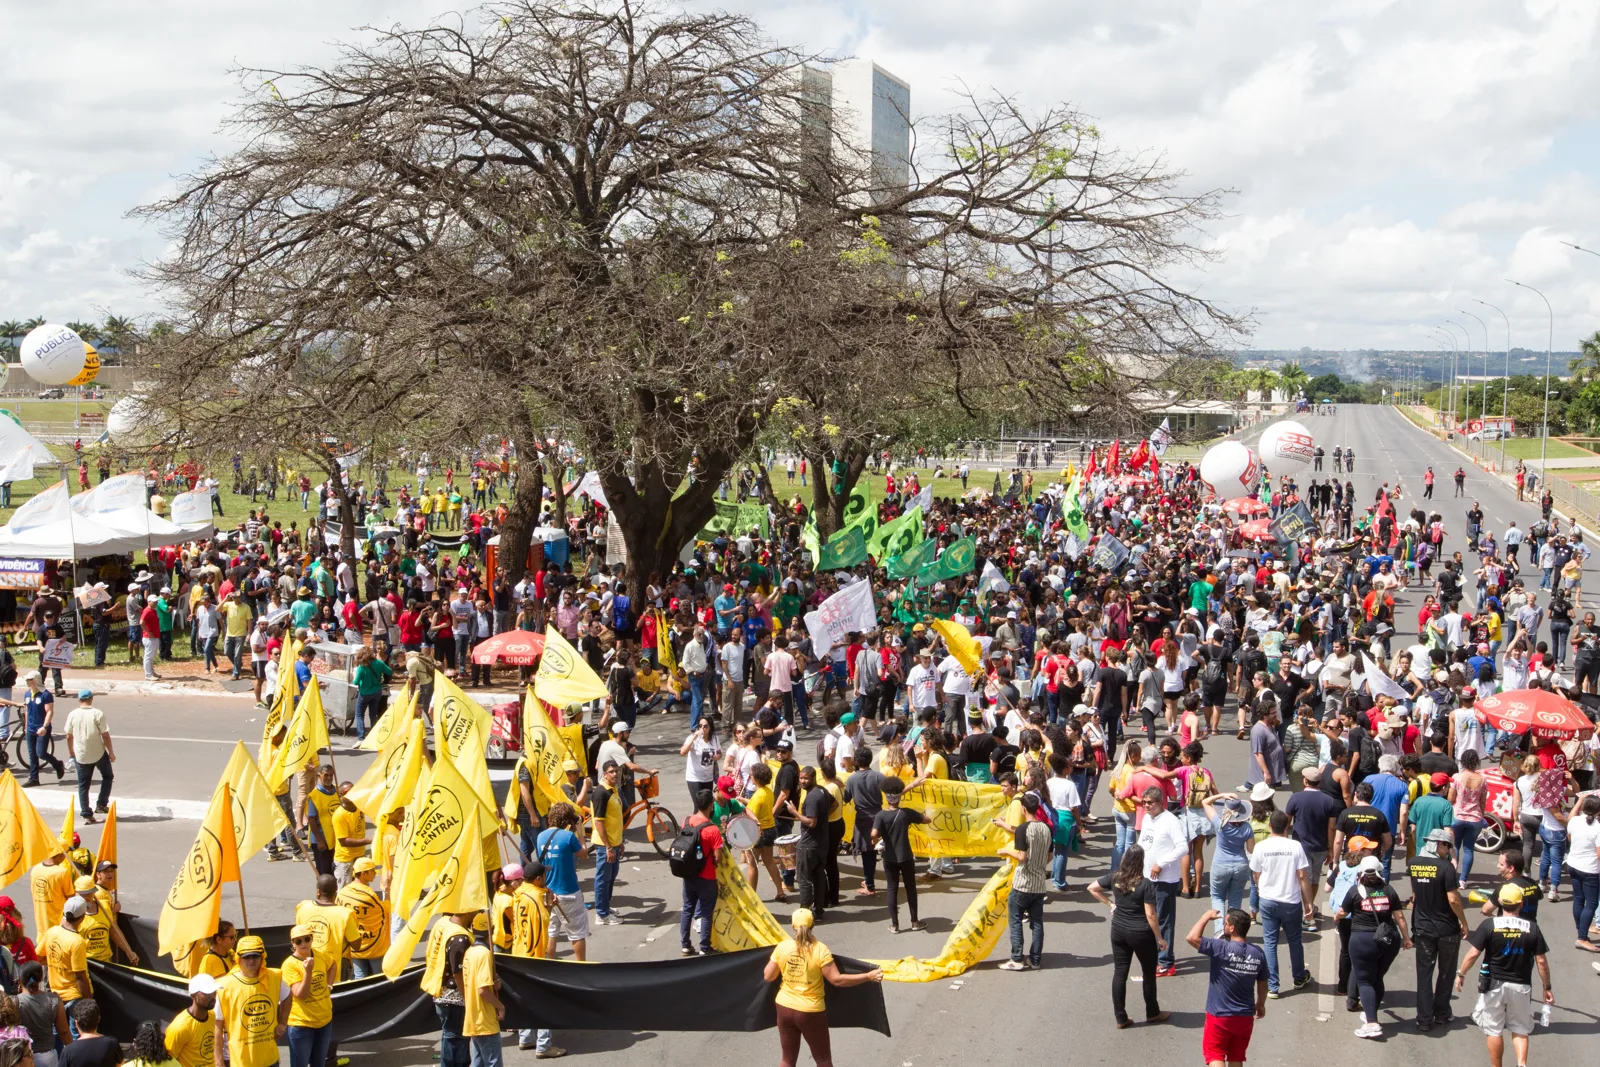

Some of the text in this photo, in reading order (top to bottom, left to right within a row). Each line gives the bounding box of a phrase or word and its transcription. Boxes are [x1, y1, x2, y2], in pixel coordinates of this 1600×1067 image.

[35, 331, 76, 359] PÚBLICA
[505, 656, 532, 664] KIBON
[452, 717, 468, 740] NOVA
[1538, 728, 1569, 739] KIBON
[420, 816, 460, 852] CENTRAL
[421, 812, 445, 839] NOVA
[193, 839, 208, 885] NCST
[249, 1005, 267, 1013] NCST
[246, 1020, 271, 1029] CENTRAL
